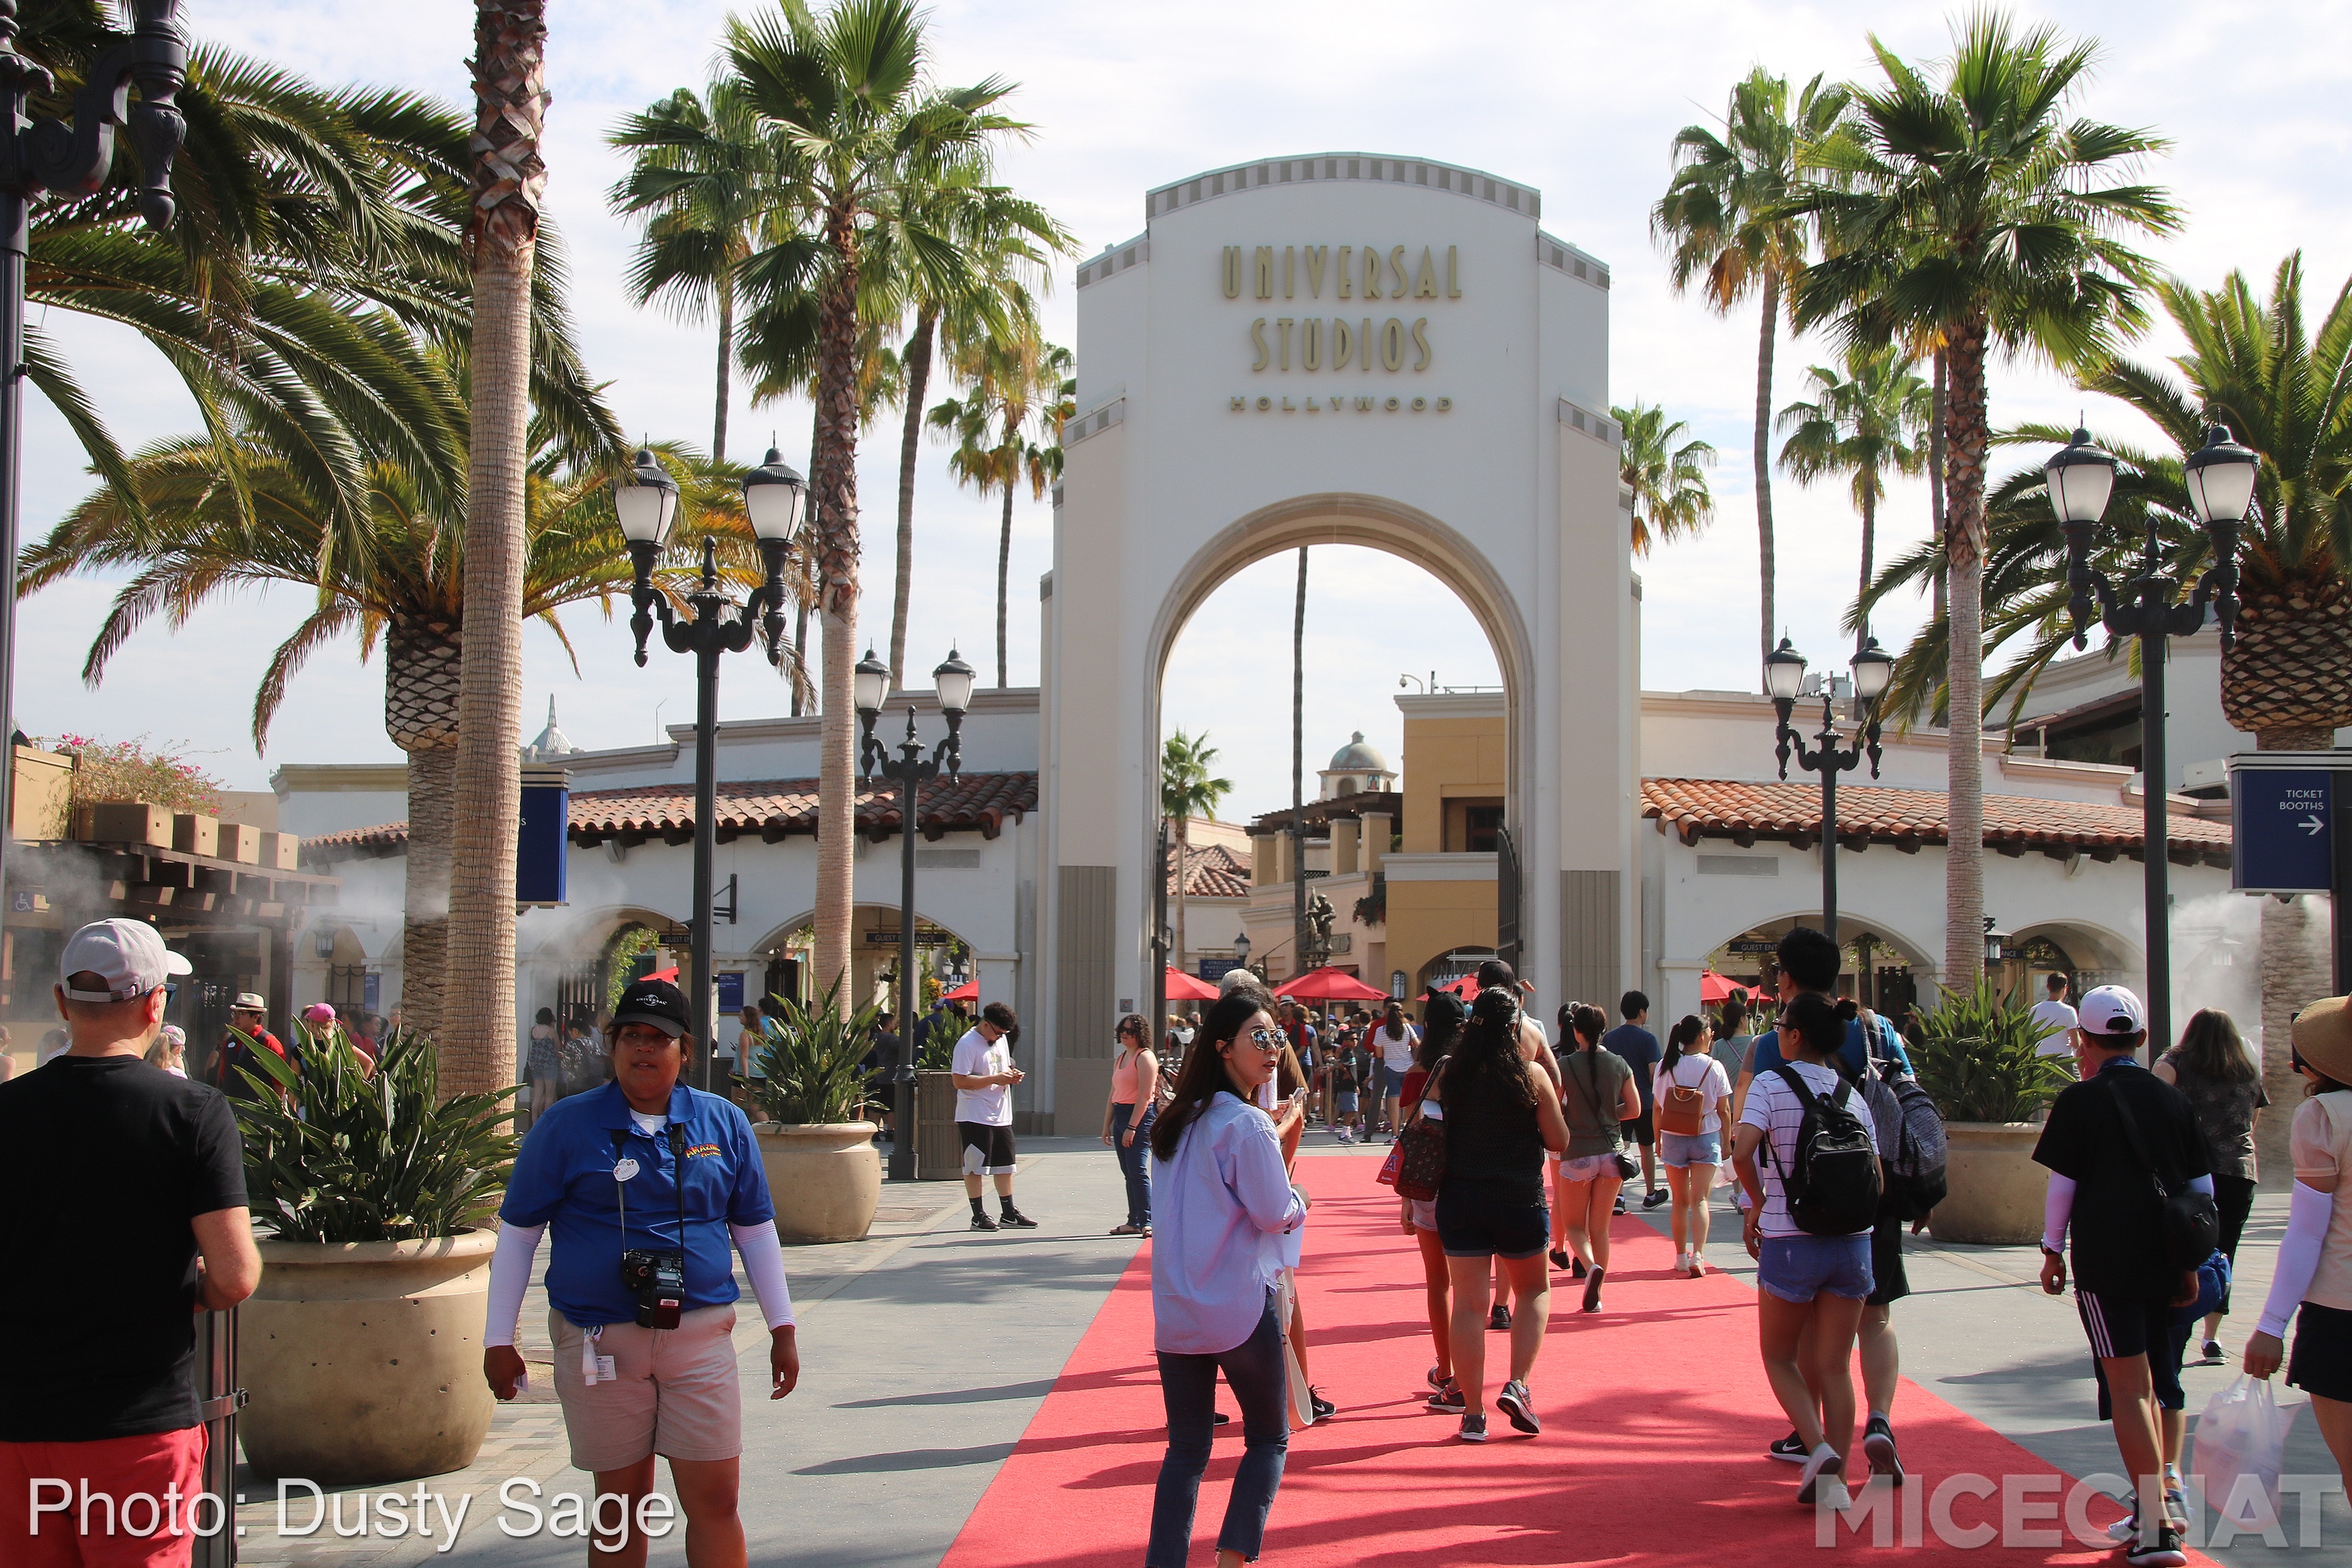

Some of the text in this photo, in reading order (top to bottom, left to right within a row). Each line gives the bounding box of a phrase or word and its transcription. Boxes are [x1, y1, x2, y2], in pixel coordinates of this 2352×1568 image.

[1222, 245, 1462, 299] UNIVERSAL
[1251, 318, 1432, 372] STUDIOS
[1230, 397, 1453, 411] HOLLYWOOD
[2285, 789, 2324, 798] TICKET
[2279, 801, 2324, 811] BOOTHS
